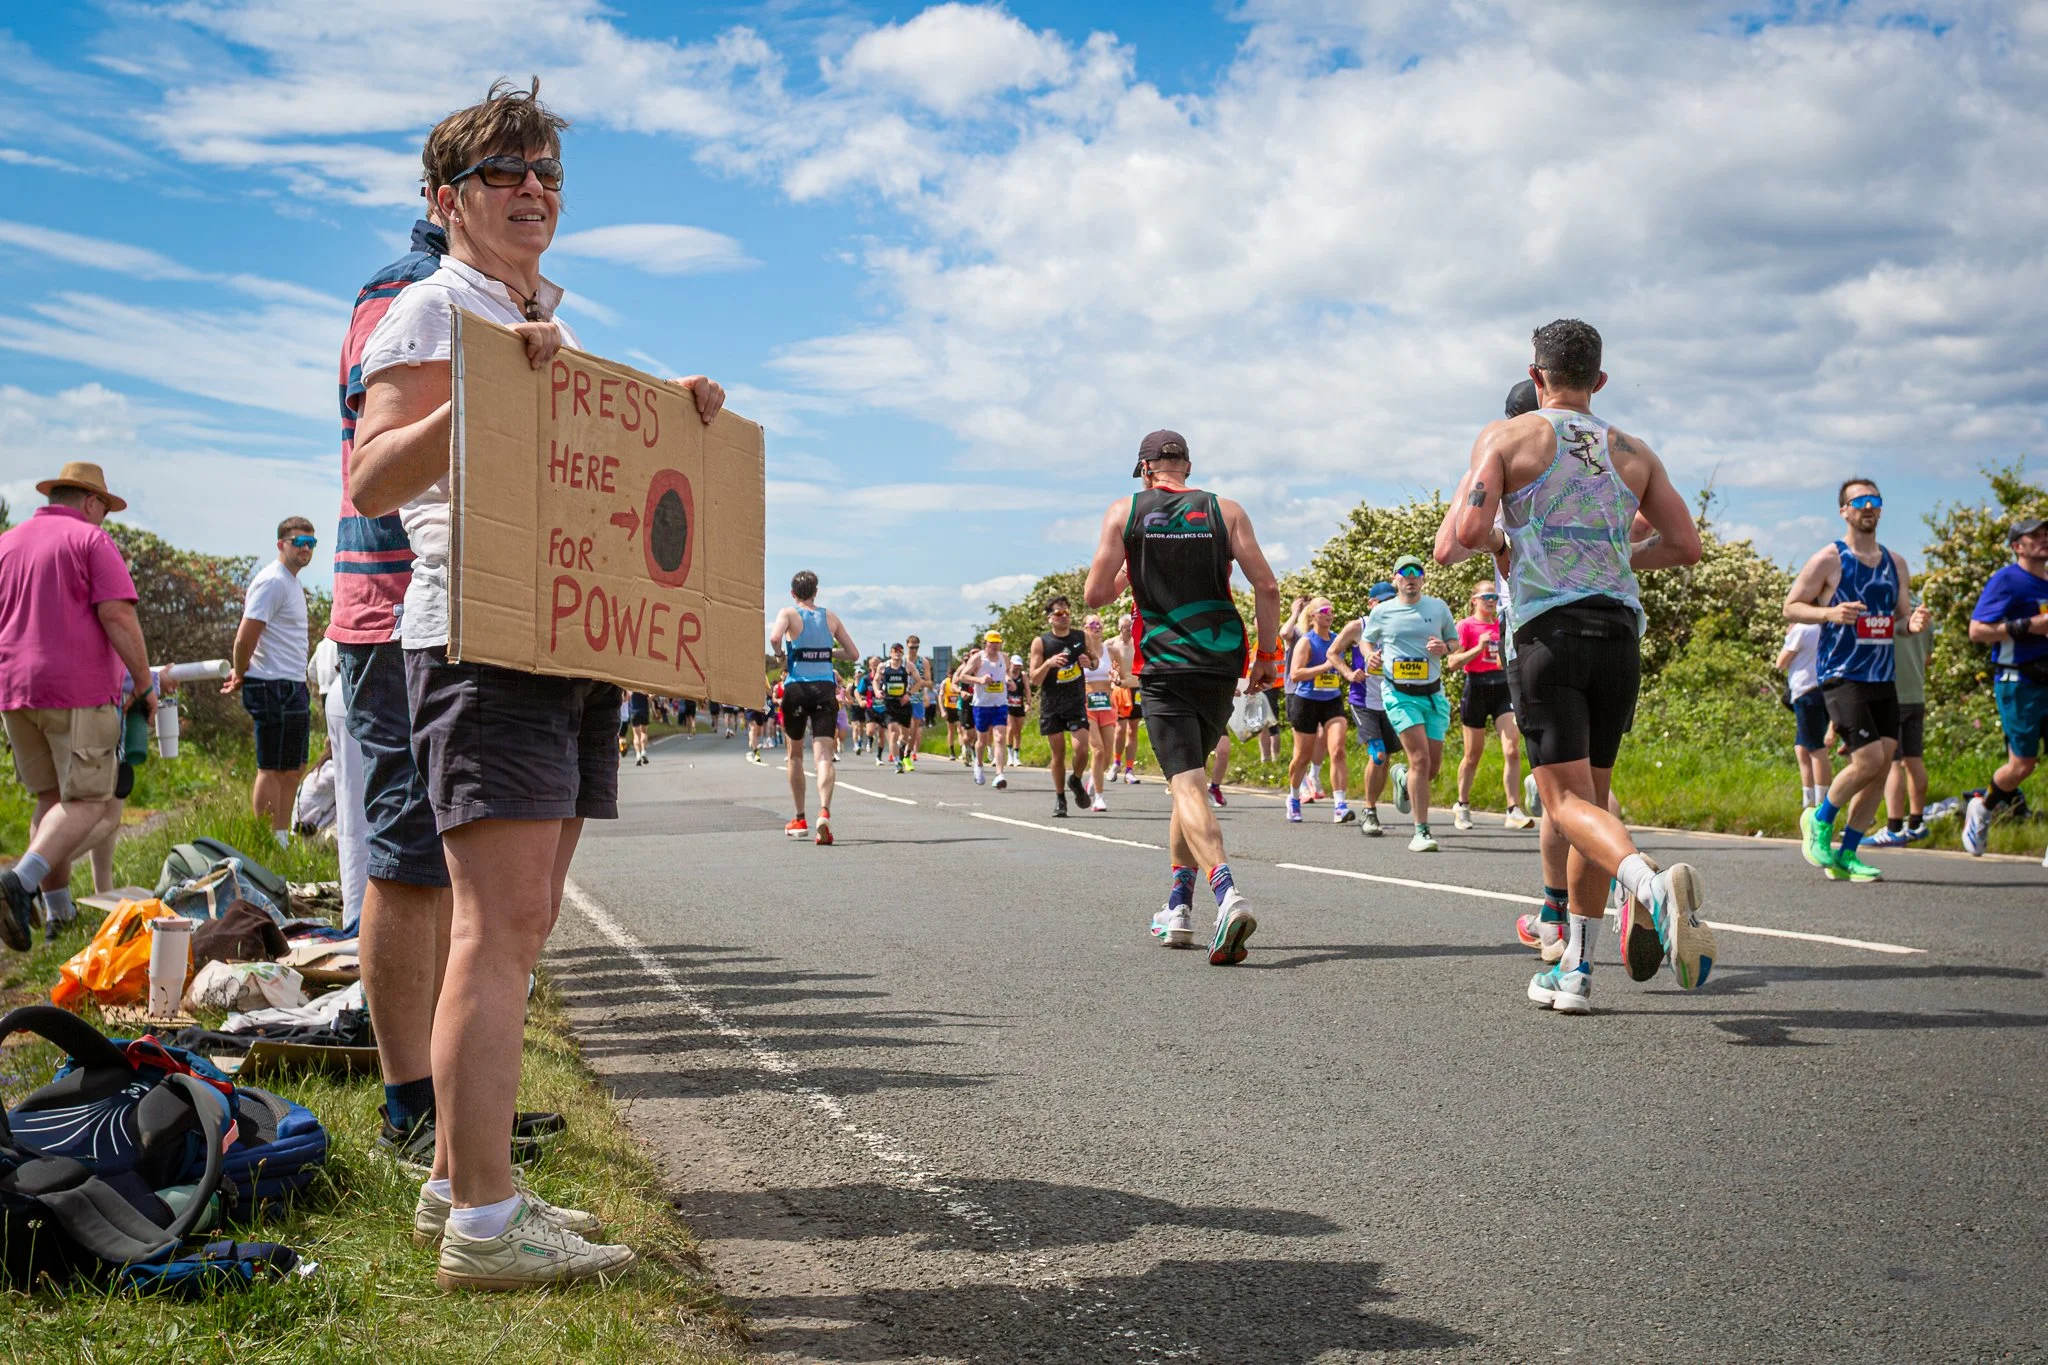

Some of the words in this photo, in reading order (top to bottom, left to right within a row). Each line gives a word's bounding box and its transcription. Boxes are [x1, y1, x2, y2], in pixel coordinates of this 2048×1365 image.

[551, 359, 660, 449] PRESS
[548, 439, 621, 494] HERE
[548, 527, 594, 572] FOR
[550, 574, 706, 684] POWER
[1865, 616, 1891, 628] 1099
